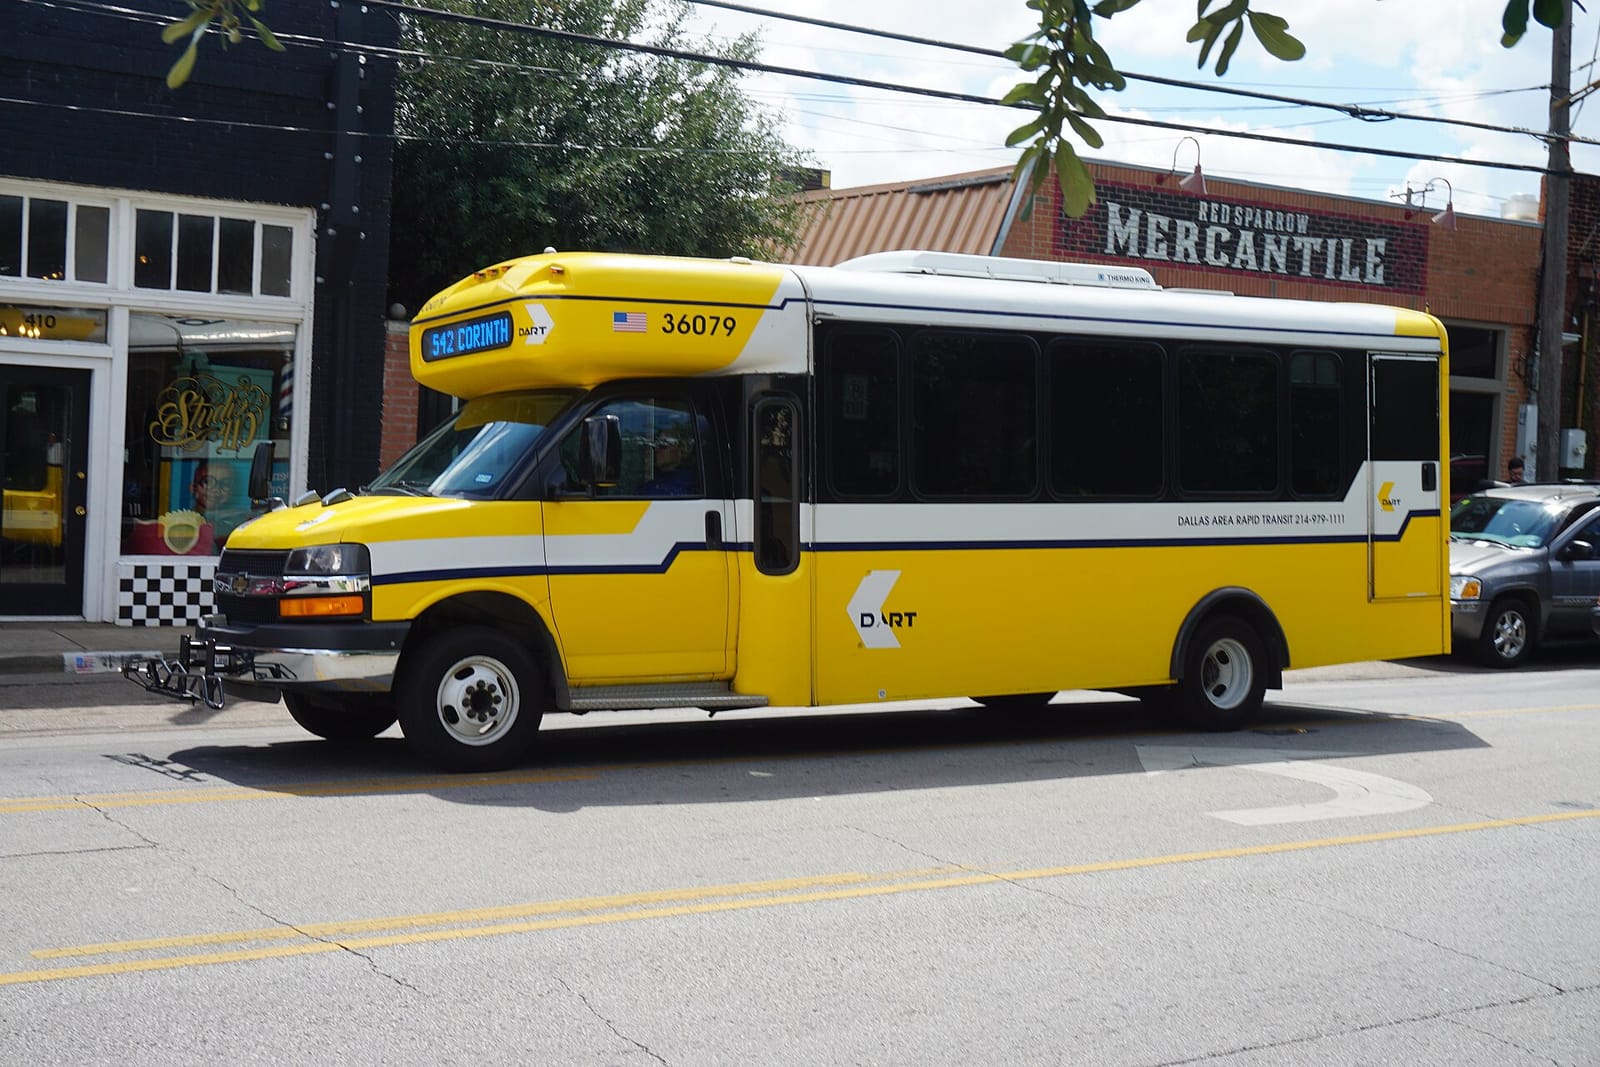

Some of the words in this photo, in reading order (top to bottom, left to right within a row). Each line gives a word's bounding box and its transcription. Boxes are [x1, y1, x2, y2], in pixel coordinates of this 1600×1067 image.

[1198, 200, 1230, 225] RED
[1234, 203, 1309, 234] SPARROW
[1103, 201, 1389, 285] MERCANTILE
[1107, 273, 1134, 283] THERMO
[1135, 276, 1150, 284] KING
[24, 313, 57, 329] 410
[661, 312, 737, 337] 36079
[431, 329, 455, 357] 542
[457, 317, 509, 352] CORINTH
[518, 325, 547, 337] DART
[1382, 498, 1401, 506] DART
[1177, 515, 1210, 527] DALLAS
[1212, 515, 1234, 526] AREA
[1236, 515, 1260, 526] RAPID
[1262, 514, 1293, 525] TRANSIT
[1295, 514, 1345, 525] 214-979-1111
[860, 611, 917, 628] DART
